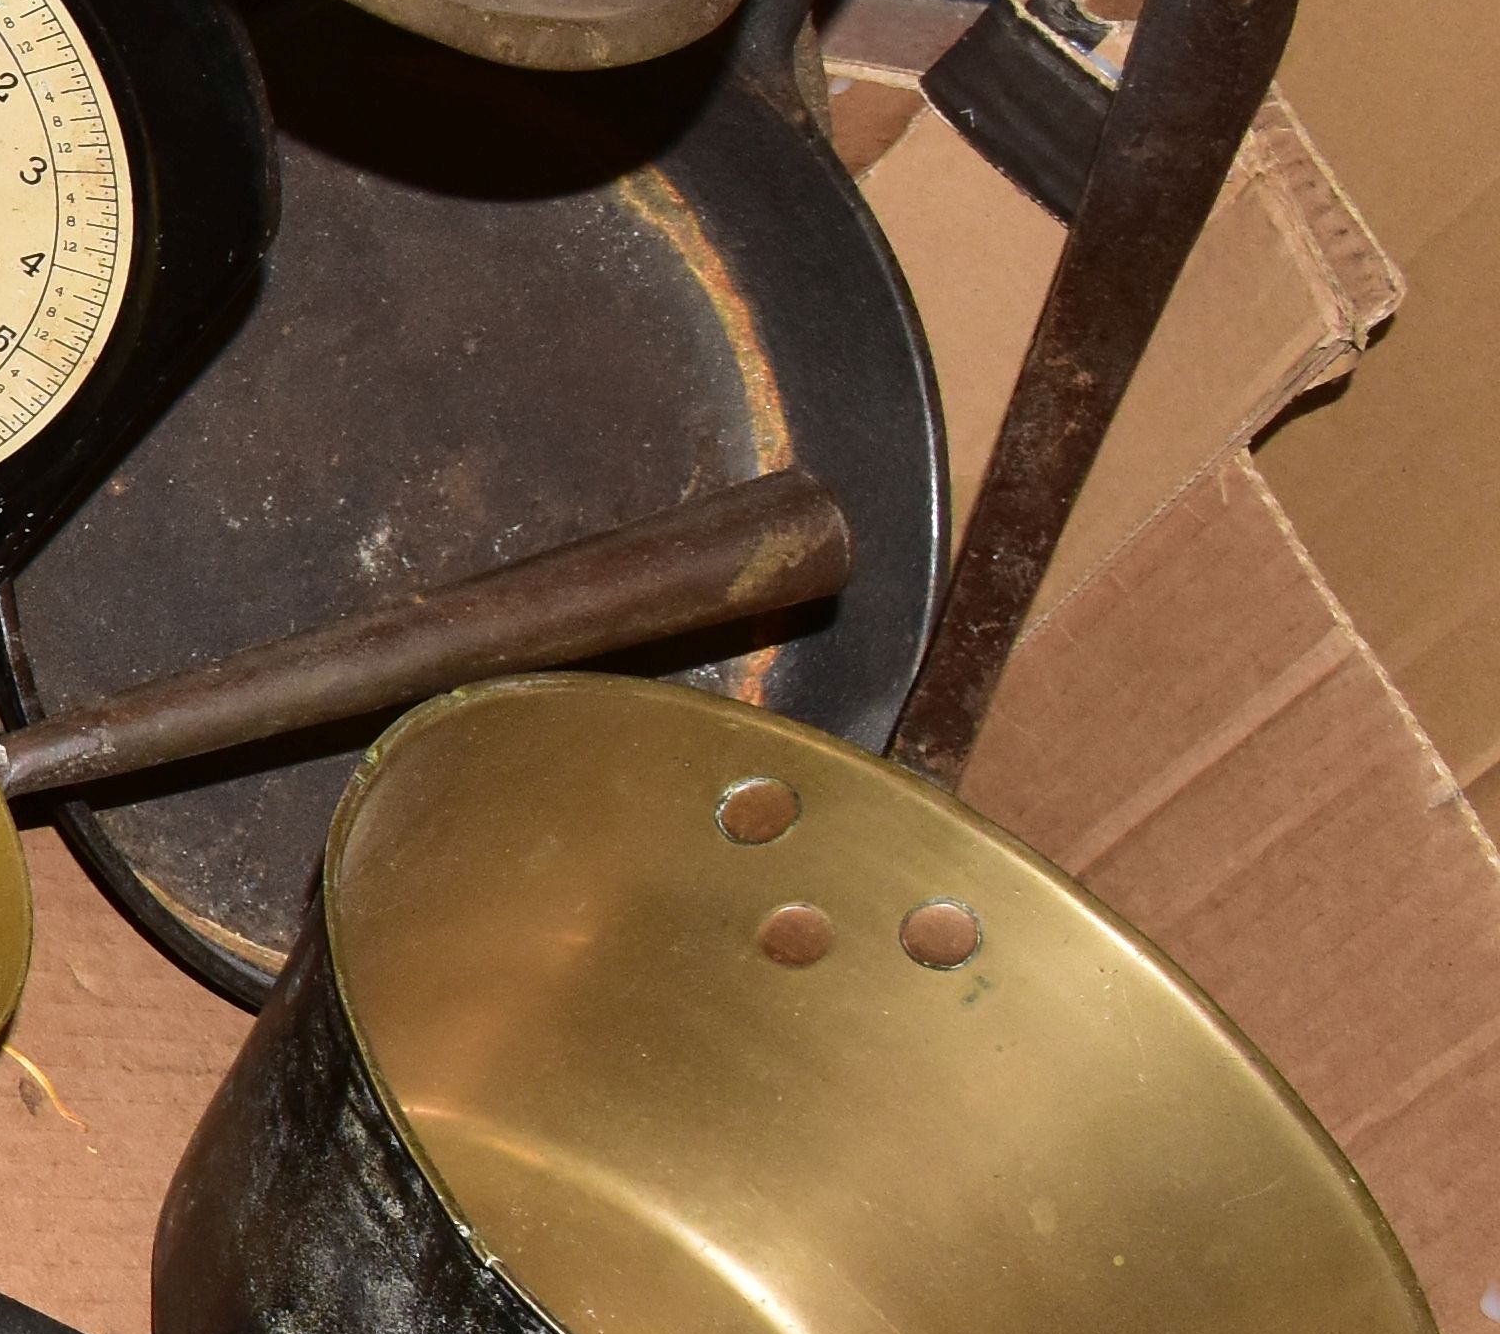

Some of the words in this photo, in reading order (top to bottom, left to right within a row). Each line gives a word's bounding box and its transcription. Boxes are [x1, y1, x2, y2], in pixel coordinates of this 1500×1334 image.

[4, 17, 15, 28] 8
[17, 41, 34, 54] 12
[45, 92, 54, 102] 4
[53, 116, 62, 127] 8
[58, 143, 72, 153] 12
[19, 156, 47, 185] 3
[66, 193, 75, 203] 4
[66, 216, 75, 227] 8
[64, 241, 77, 252] 12
[20, 253, 45, 277] 4
[55, 287, 63, 297] 4
[46, 307, 56, 317] 8
[35, 328, 49, 341] 12
